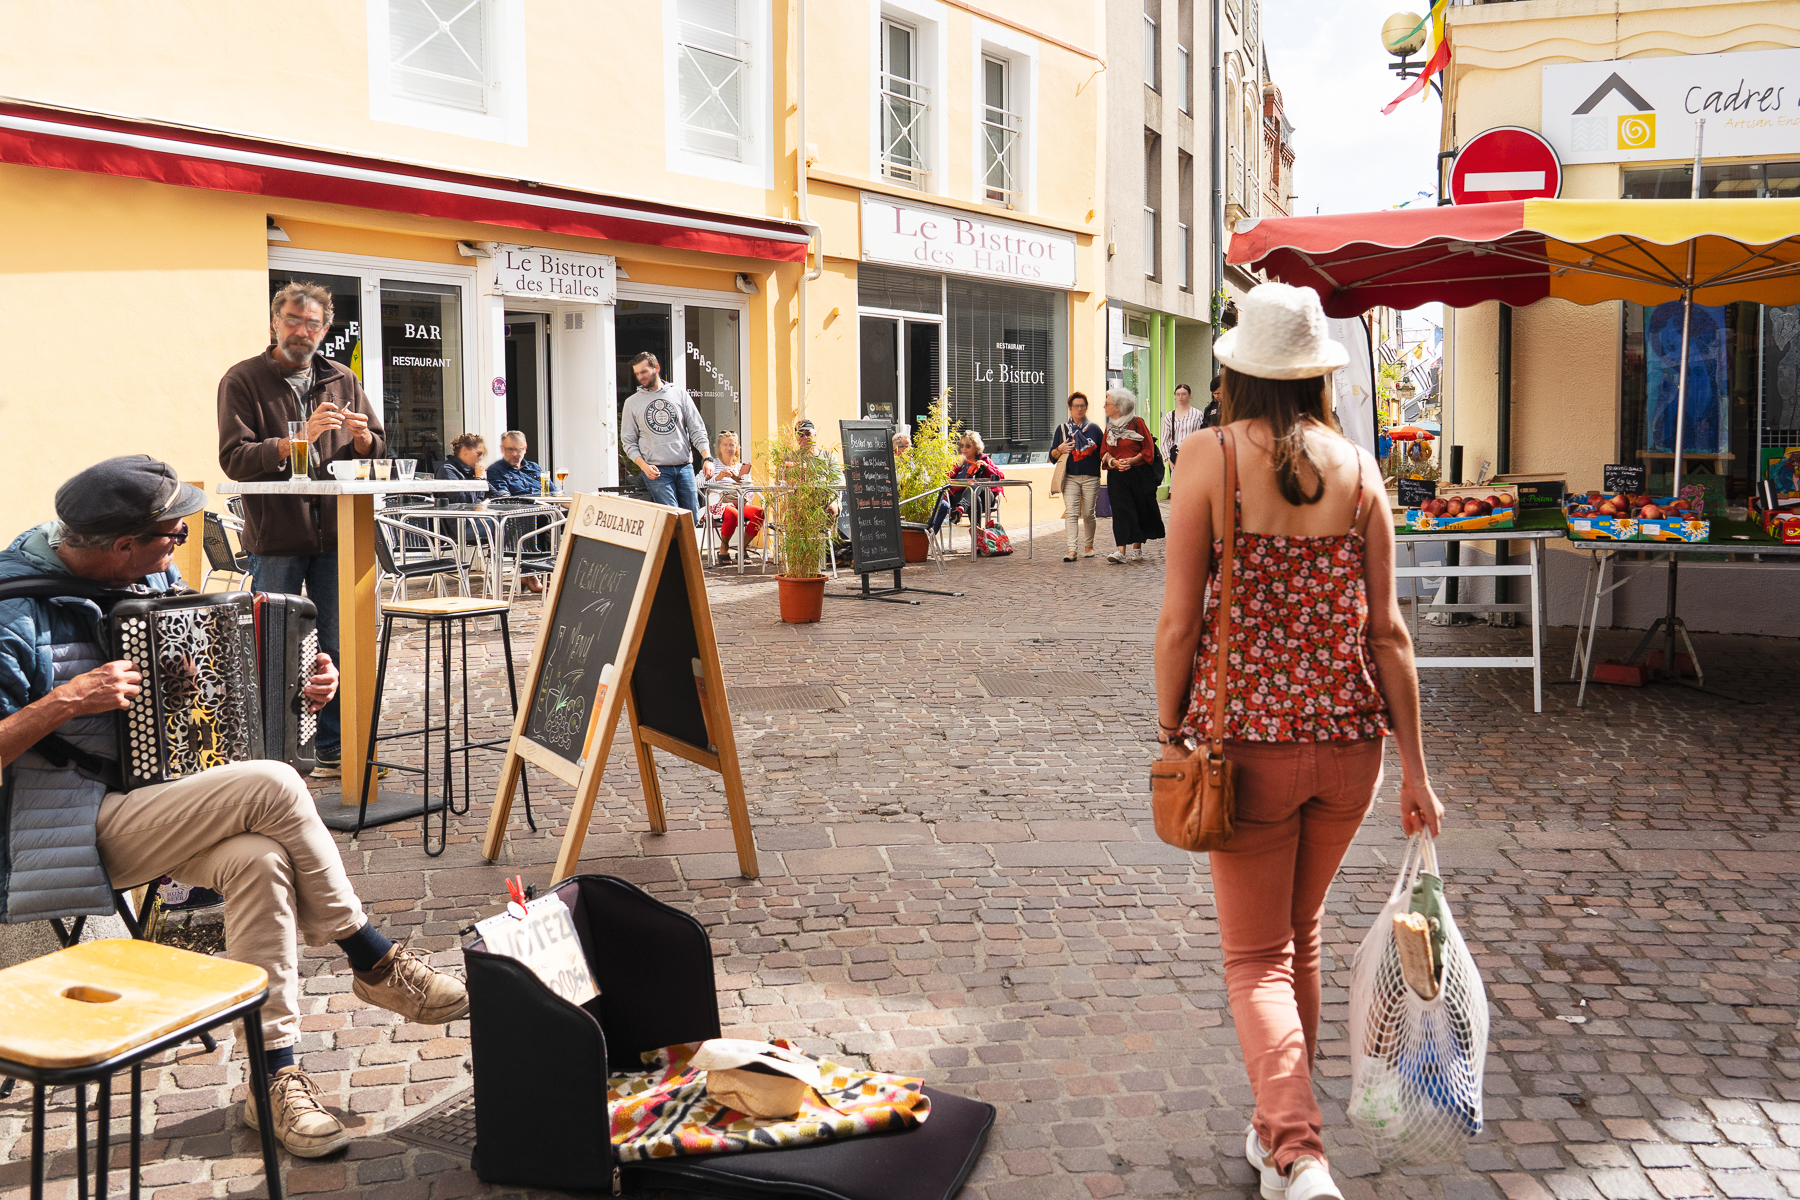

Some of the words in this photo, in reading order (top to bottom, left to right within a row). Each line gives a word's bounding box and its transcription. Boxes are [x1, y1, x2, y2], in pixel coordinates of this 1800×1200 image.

[1684, 78, 1785, 114] Cadres
[1724, 116, 1774, 129] Artisan
[891, 206, 938, 241] Le
[952, 217, 1057, 261] Bistrot
[506, 251, 532, 272] Le
[540, 255, 605, 279] Bistrot
[914, 241, 954, 265] des
[973, 249, 1041, 279] Halles
[515, 274, 543, 293] des
[549, 277, 599, 297] Halles
[404, 323, 442, 340] BAR
[996, 342, 1026, 351] RESTAURANT
[392, 356, 452, 368] RESTAURANT
[686, 341, 739, 403] BRASSERIE
[974, 361, 994, 383] Le
[999, 363, 1045, 385] Bistrot
[704, 389, 725, 398] maison
[595, 510, 645, 537] PAULANER
[1444, 521, 1464, 530] Frais
